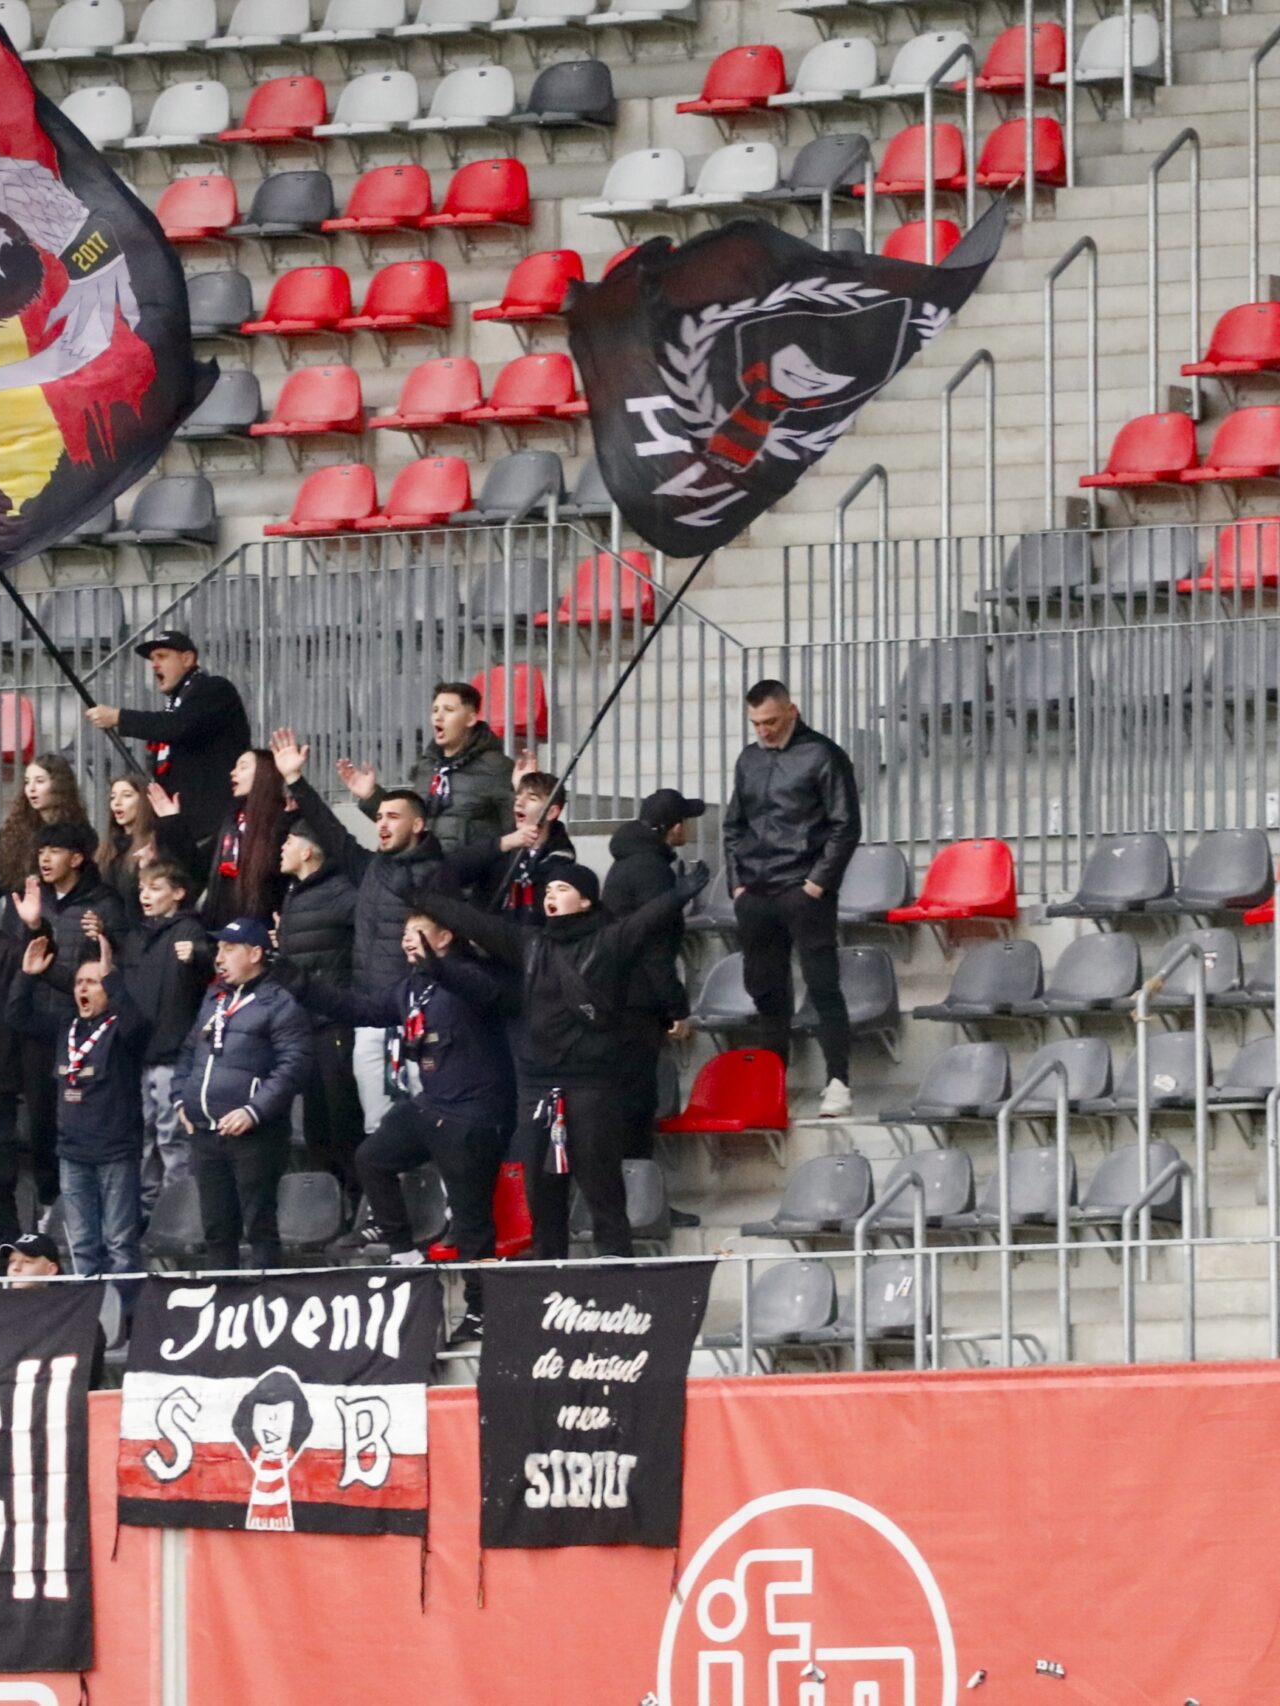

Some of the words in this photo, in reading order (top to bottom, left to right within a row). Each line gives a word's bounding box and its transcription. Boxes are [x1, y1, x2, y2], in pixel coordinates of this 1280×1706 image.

[71, 230, 109, 272] 2017
[160, 1276, 412, 1361] Juvenil
[540, 1291, 652, 1335] Mândru
[532, 1347, 564, 1379] de
[143, 1386, 203, 1483] S
[334, 1395, 393, 1490] B
[524, 1449, 638, 1510] SIBIU
